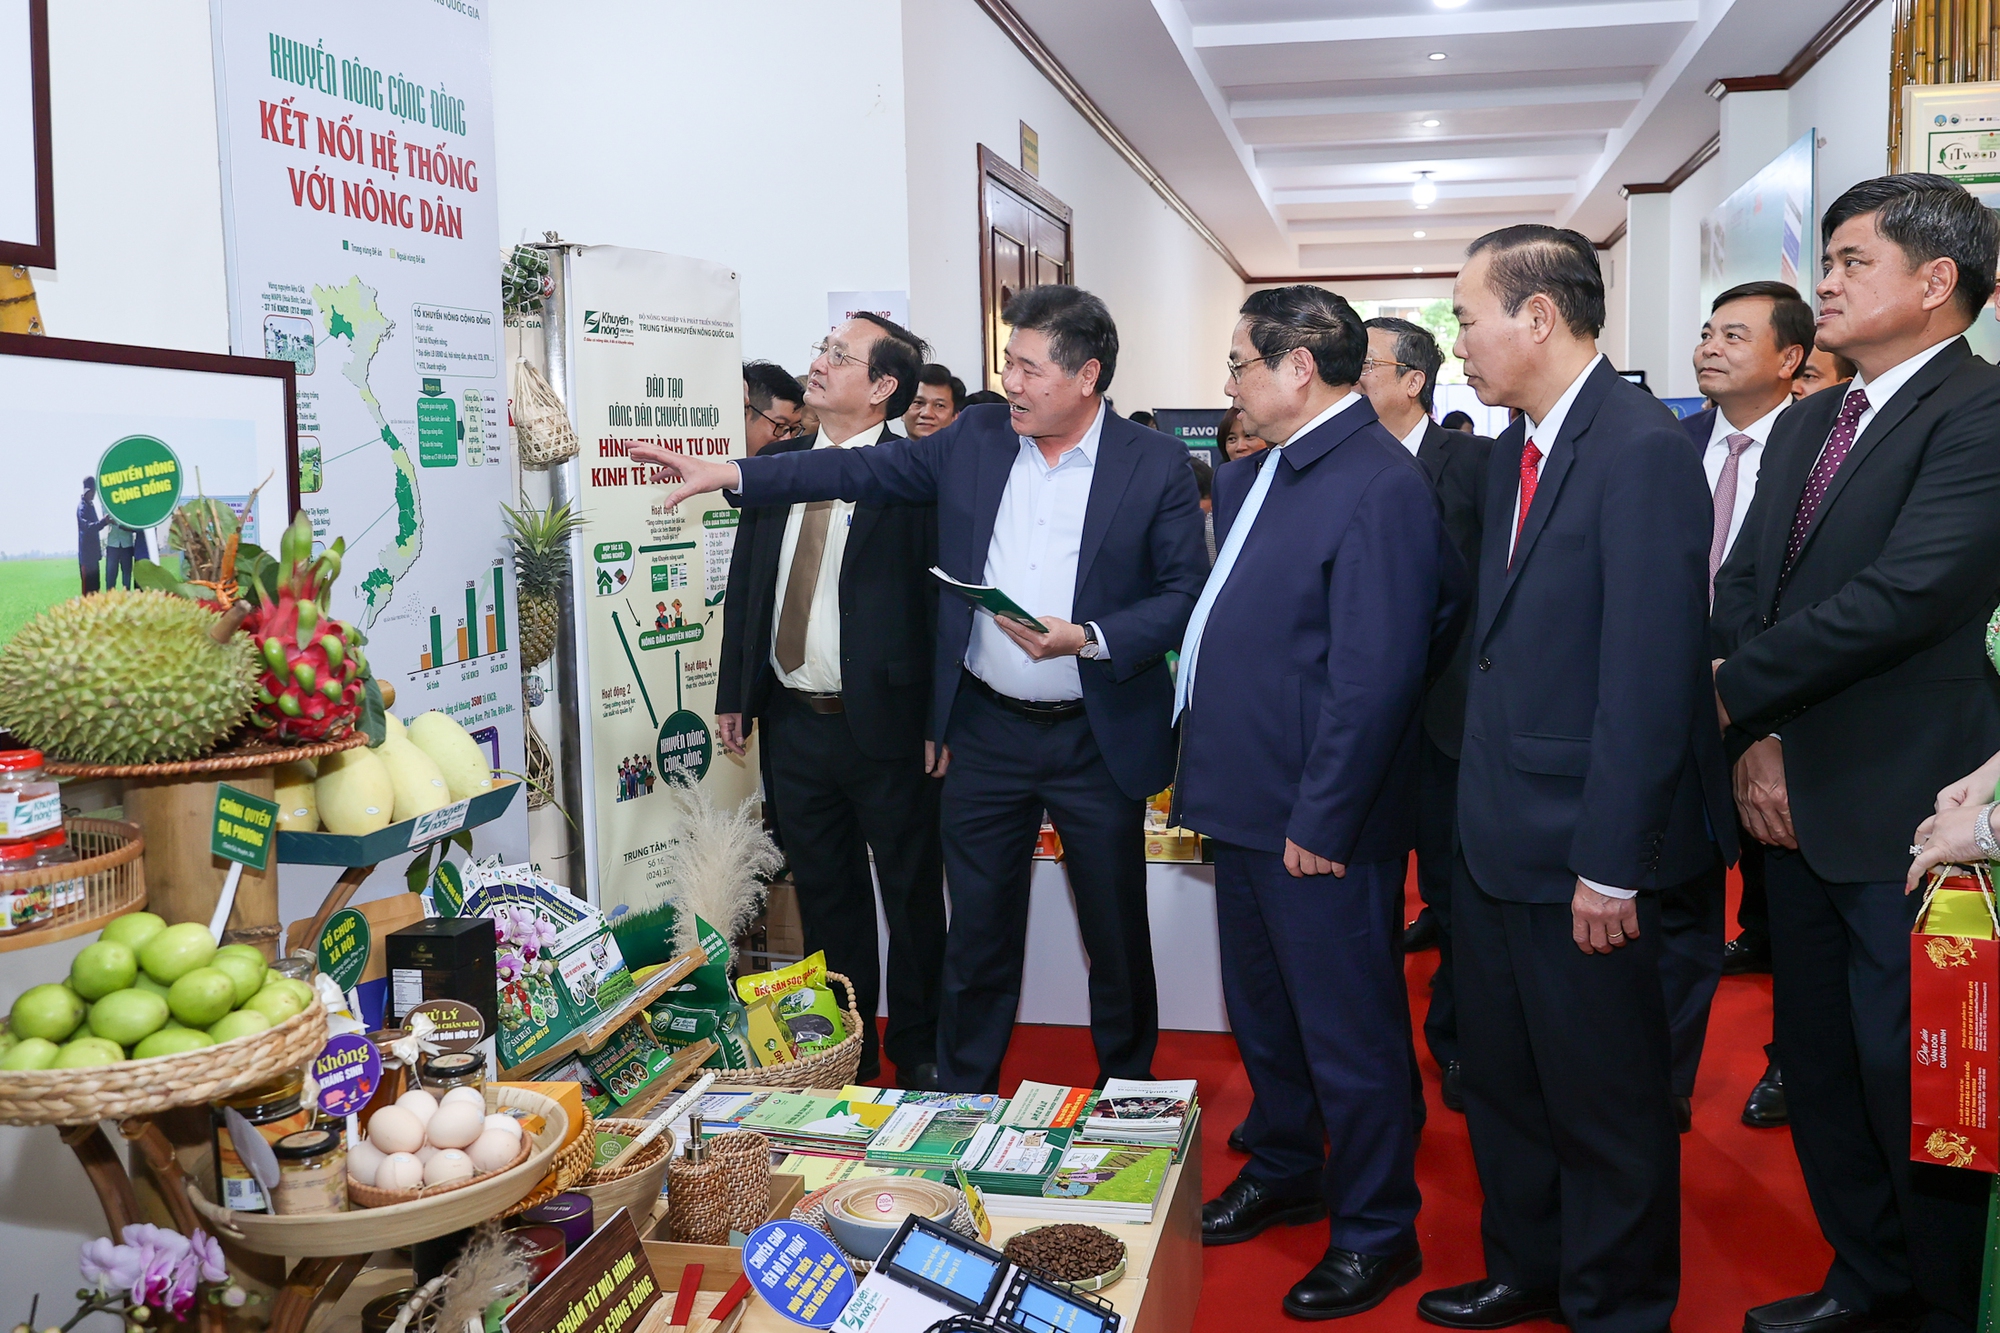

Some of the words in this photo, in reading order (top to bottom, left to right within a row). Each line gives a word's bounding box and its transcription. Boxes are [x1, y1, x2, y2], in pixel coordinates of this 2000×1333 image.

[269, 32, 337, 97] KHUYẾN
[342, 56, 384, 111] NÔNG
[388, 72, 426, 124] CỘNG
[430, 82, 466, 137] ĐỒNG
[259, 96, 309, 150] KẾT
[316, 114, 364, 165] NỐI
[370, 130, 399, 181] HỆ
[404, 142, 478, 193] THỐNG
[287, 165, 336, 214] VỚI
[342, 178, 414, 229] NÔNG
[420, 195, 463, 240] DÂN
[414, 306, 422, 317] TỔ
[443, 311, 459, 322] NÔNG
[460, 313, 475, 324] CỘNG
[476, 314, 491, 326] ĐỒNG
[646, 313, 661, 321] NÔNG
[661, 314, 679, 323] NGHIỆP
[639, 323, 660, 333] TRUNG
[660, 322, 674, 334] TÂM
[674, 324, 697, 336] KHUYẾN
[697, 326, 711, 337] NÔNG
[711, 326, 725, 338] QUỐC
[725, 330, 735, 339] GIA
[646, 373, 664, 398] ĐÀO
[667, 377, 683, 401] TẠO
[609, 402, 633, 427] NÔNG
[634, 402, 653, 427] DÂN
[655, 403, 688, 427] CHUYÊN
[690, 404, 720, 430] NGHIỆP
[686, 437, 704, 456] TƯ
[706, 438, 730, 456] DUY
[101, 465, 144, 487] KHUYẾN
[144, 460, 175, 478] NÔNG
[591, 467, 628, 487] KINH
[111, 485, 142, 505] CỘNG
[141, 479, 172, 497] ĐỒNG
[641, 634, 656, 646] NÔNG
[656, 632, 667, 645] DÂN
[685, 628, 702, 641] NGHIỆP
[422, 644, 427, 652] 13
[684, 661, 696, 673] Hoạt
[696, 659, 708, 671] động
[708, 658, 713, 667] 4
[471, 694, 482, 707] 3500
[601, 687, 613, 699] Hoạt
[613, 686, 626, 699] động
[626, 684, 632, 694] 2
[660, 730, 686, 754] KHUYẾN
[686, 729, 706, 749] NÔNG
[663, 756, 682, 774] CỘNG
[682, 749, 703, 768] ĐỒNG
[218, 797, 245, 819] CHÍNH
[218, 818, 232, 838] ĐỊA
[232, 823, 264, 847] PHƯƠNG
[623, 846, 649, 862] TRUNG
[649, 841, 667, 855] TÂM
[647, 859, 656, 868] Số
[646, 869, 662, 881] (024)
[499, 909, 508, 920] 5
[541, 912, 548, 923] 8
[322, 929, 334, 950] TỔ
[333, 916, 356, 942] CHỨC
[329, 943, 341, 964] XÃ
[341, 933, 356, 951] HỘI
[771, 979, 787, 993] SẢN
[441, 1021, 460, 1030] CHĂN
[461, 1019, 480, 1028] NUÔI
[442, 1007, 460, 1021] LÝ
[440, 1030, 455, 1040] BÓN
[455, 1029, 469, 1040] HỮU
[469, 1028, 480, 1039] CƠ
[1939, 1029, 1947, 1045] NINH
[316, 1043, 370, 1075] Không
[1930, 1049, 1938, 1062] VÂN
[1938, 1045, 1947, 1069] QUẢNG
[319, 1070, 345, 1090] KHÁNG
[345, 1063, 364, 1080] SINH
[749, 1241, 776, 1270] CHUYỂN
[766, 1226, 787, 1248] GIAO
[784, 1233, 808, 1259] THUẬT
[771, 1259, 790, 1277] BỘ
[778, 1250, 794, 1268] KỸ
[584, 1286, 600, 1313] TỪ
[597, 1270, 616, 1301] MÔ
[611, 1251, 636, 1285] HÌNH
[761, 1270, 781, 1289] TIẾN
[784, 1272, 802, 1291] PHÁT
[795, 1255, 814, 1276] TRIỂN
[786, 1296, 804, 1315] NUÔI
[796, 1277, 817, 1300] TRỒNG
[810, 1262, 827, 1282] THỦY
[820, 1251, 836, 1269] SẢN
[604, 1298, 633, 1333] CỘNG
[628, 1274, 655, 1311] ĐỒNG
[800, 1302, 819, 1322] TRÊN
[811, 1288, 828, 1308] BIỂN
